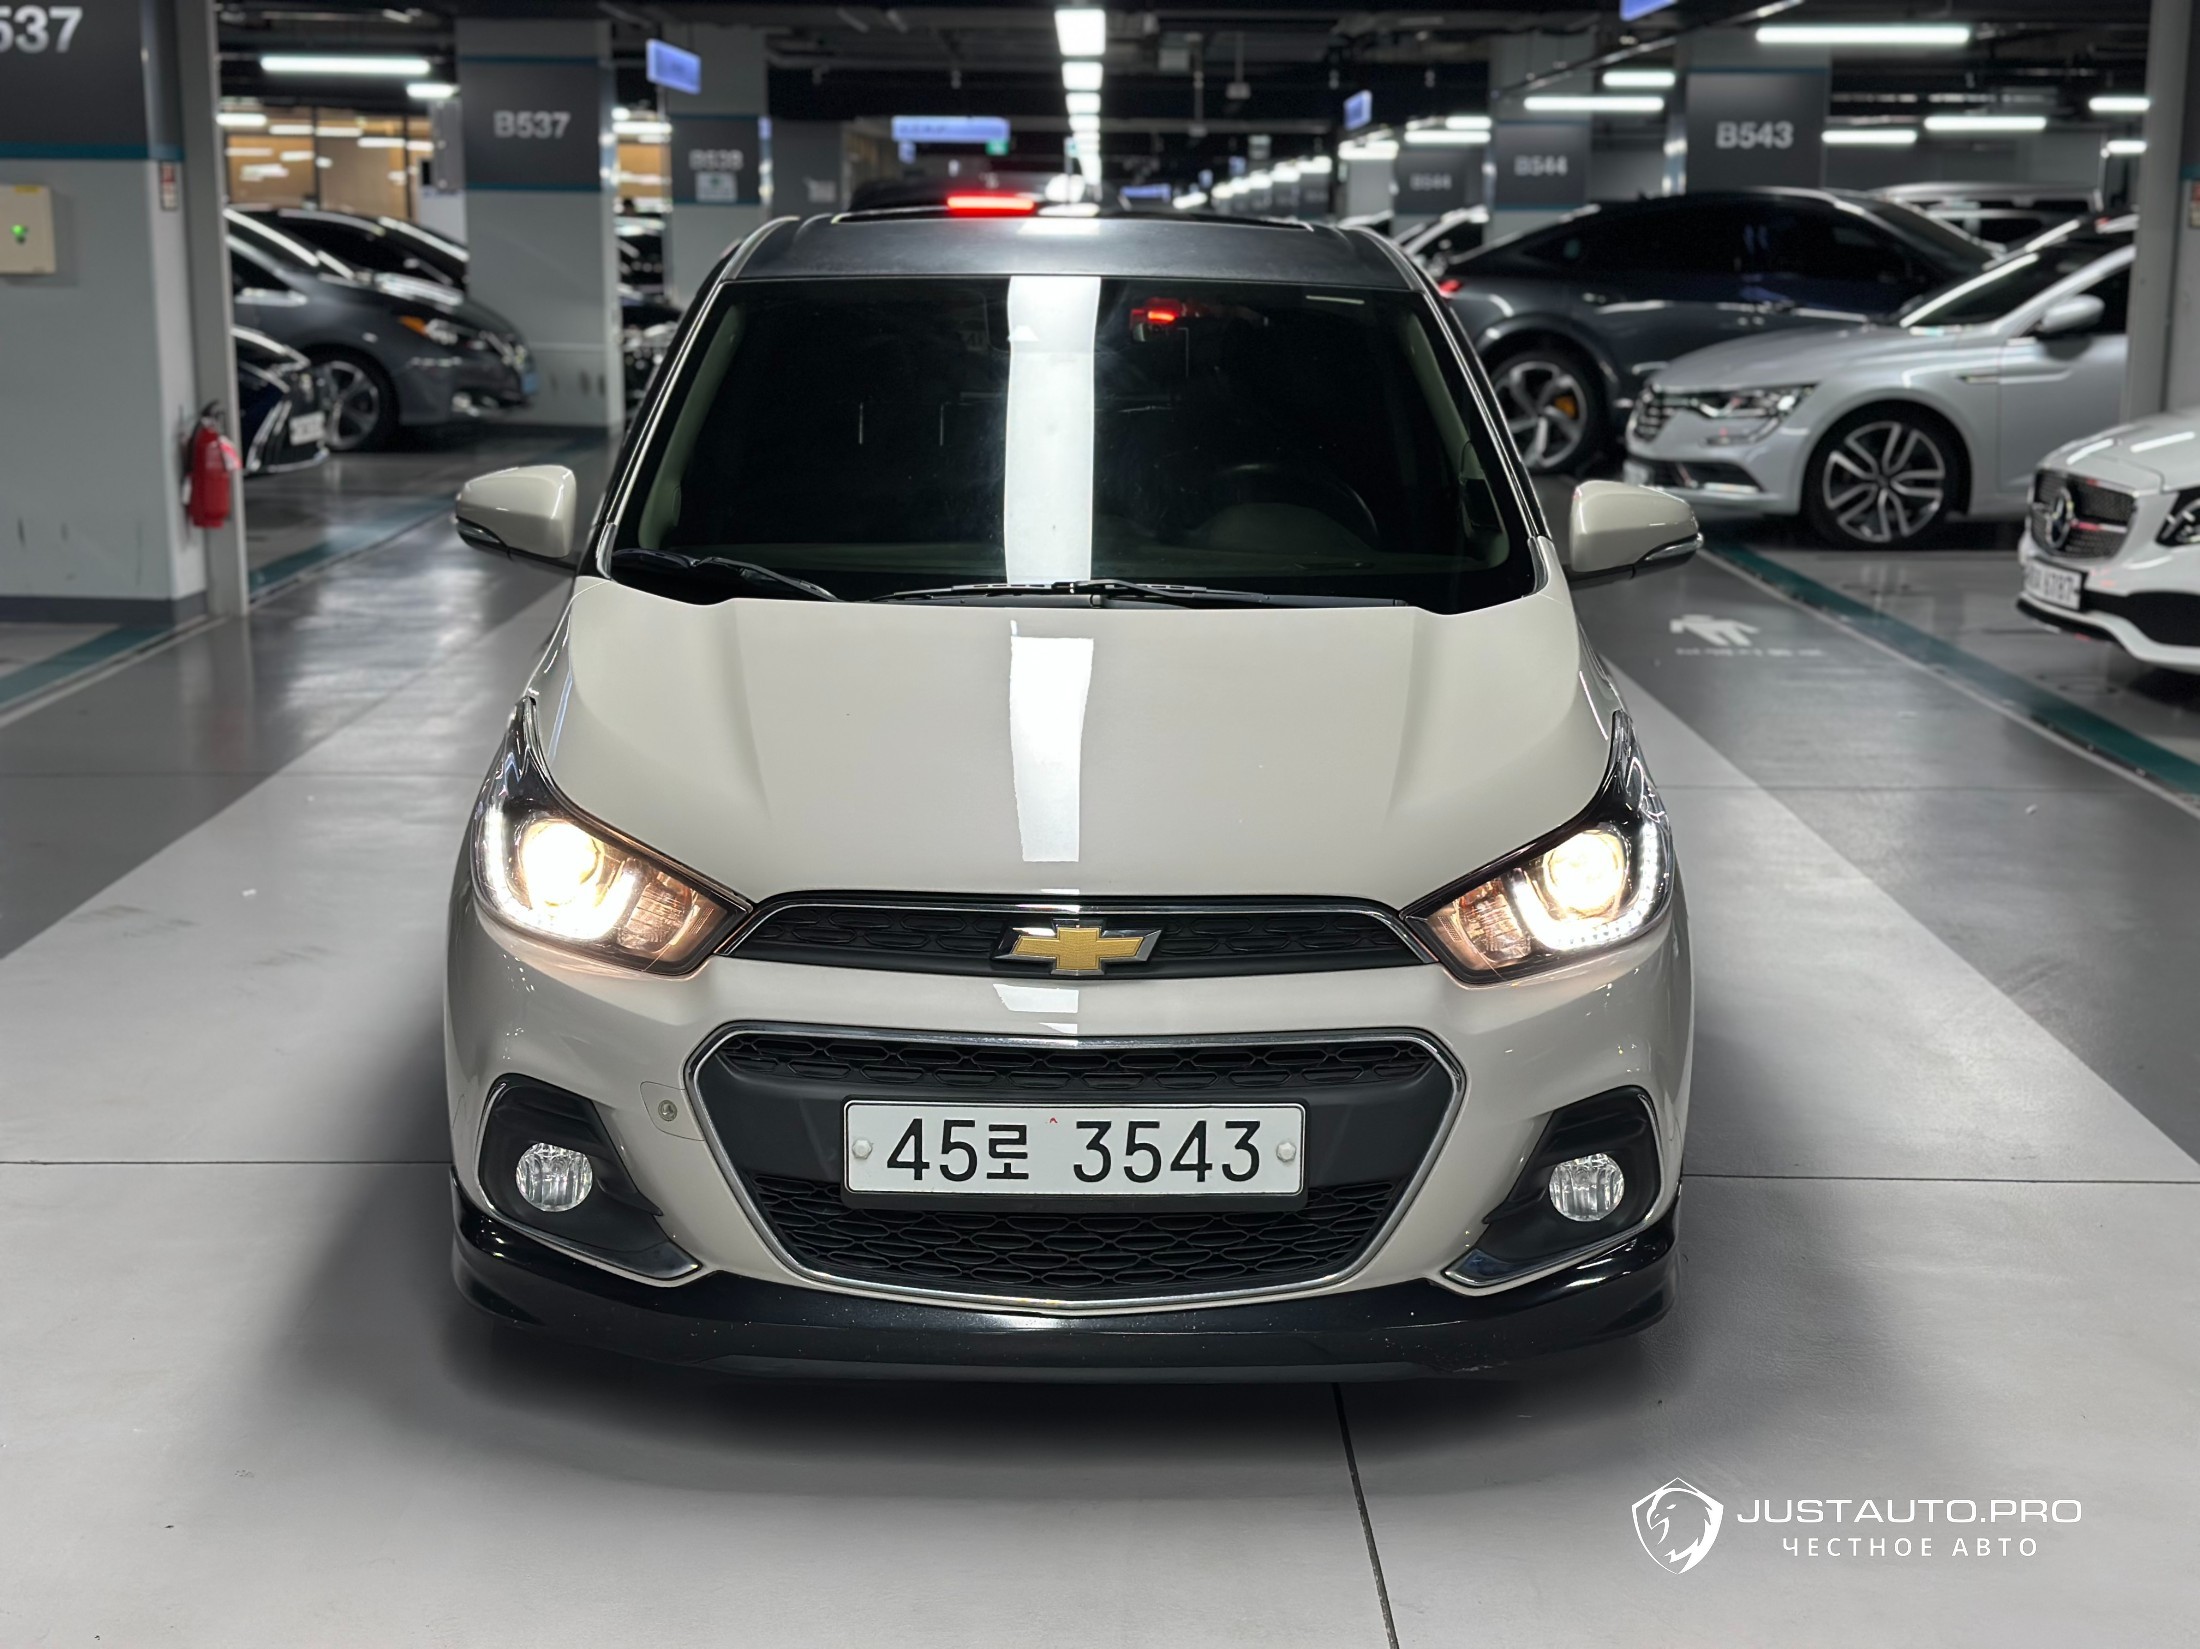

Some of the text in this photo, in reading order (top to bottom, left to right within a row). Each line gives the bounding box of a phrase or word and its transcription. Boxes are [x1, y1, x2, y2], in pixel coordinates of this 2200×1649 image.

[494, 110, 571, 139] B537
[1716, 121, 1794, 149] B543
[886, 1118, 1261, 1184] 45로 3543
